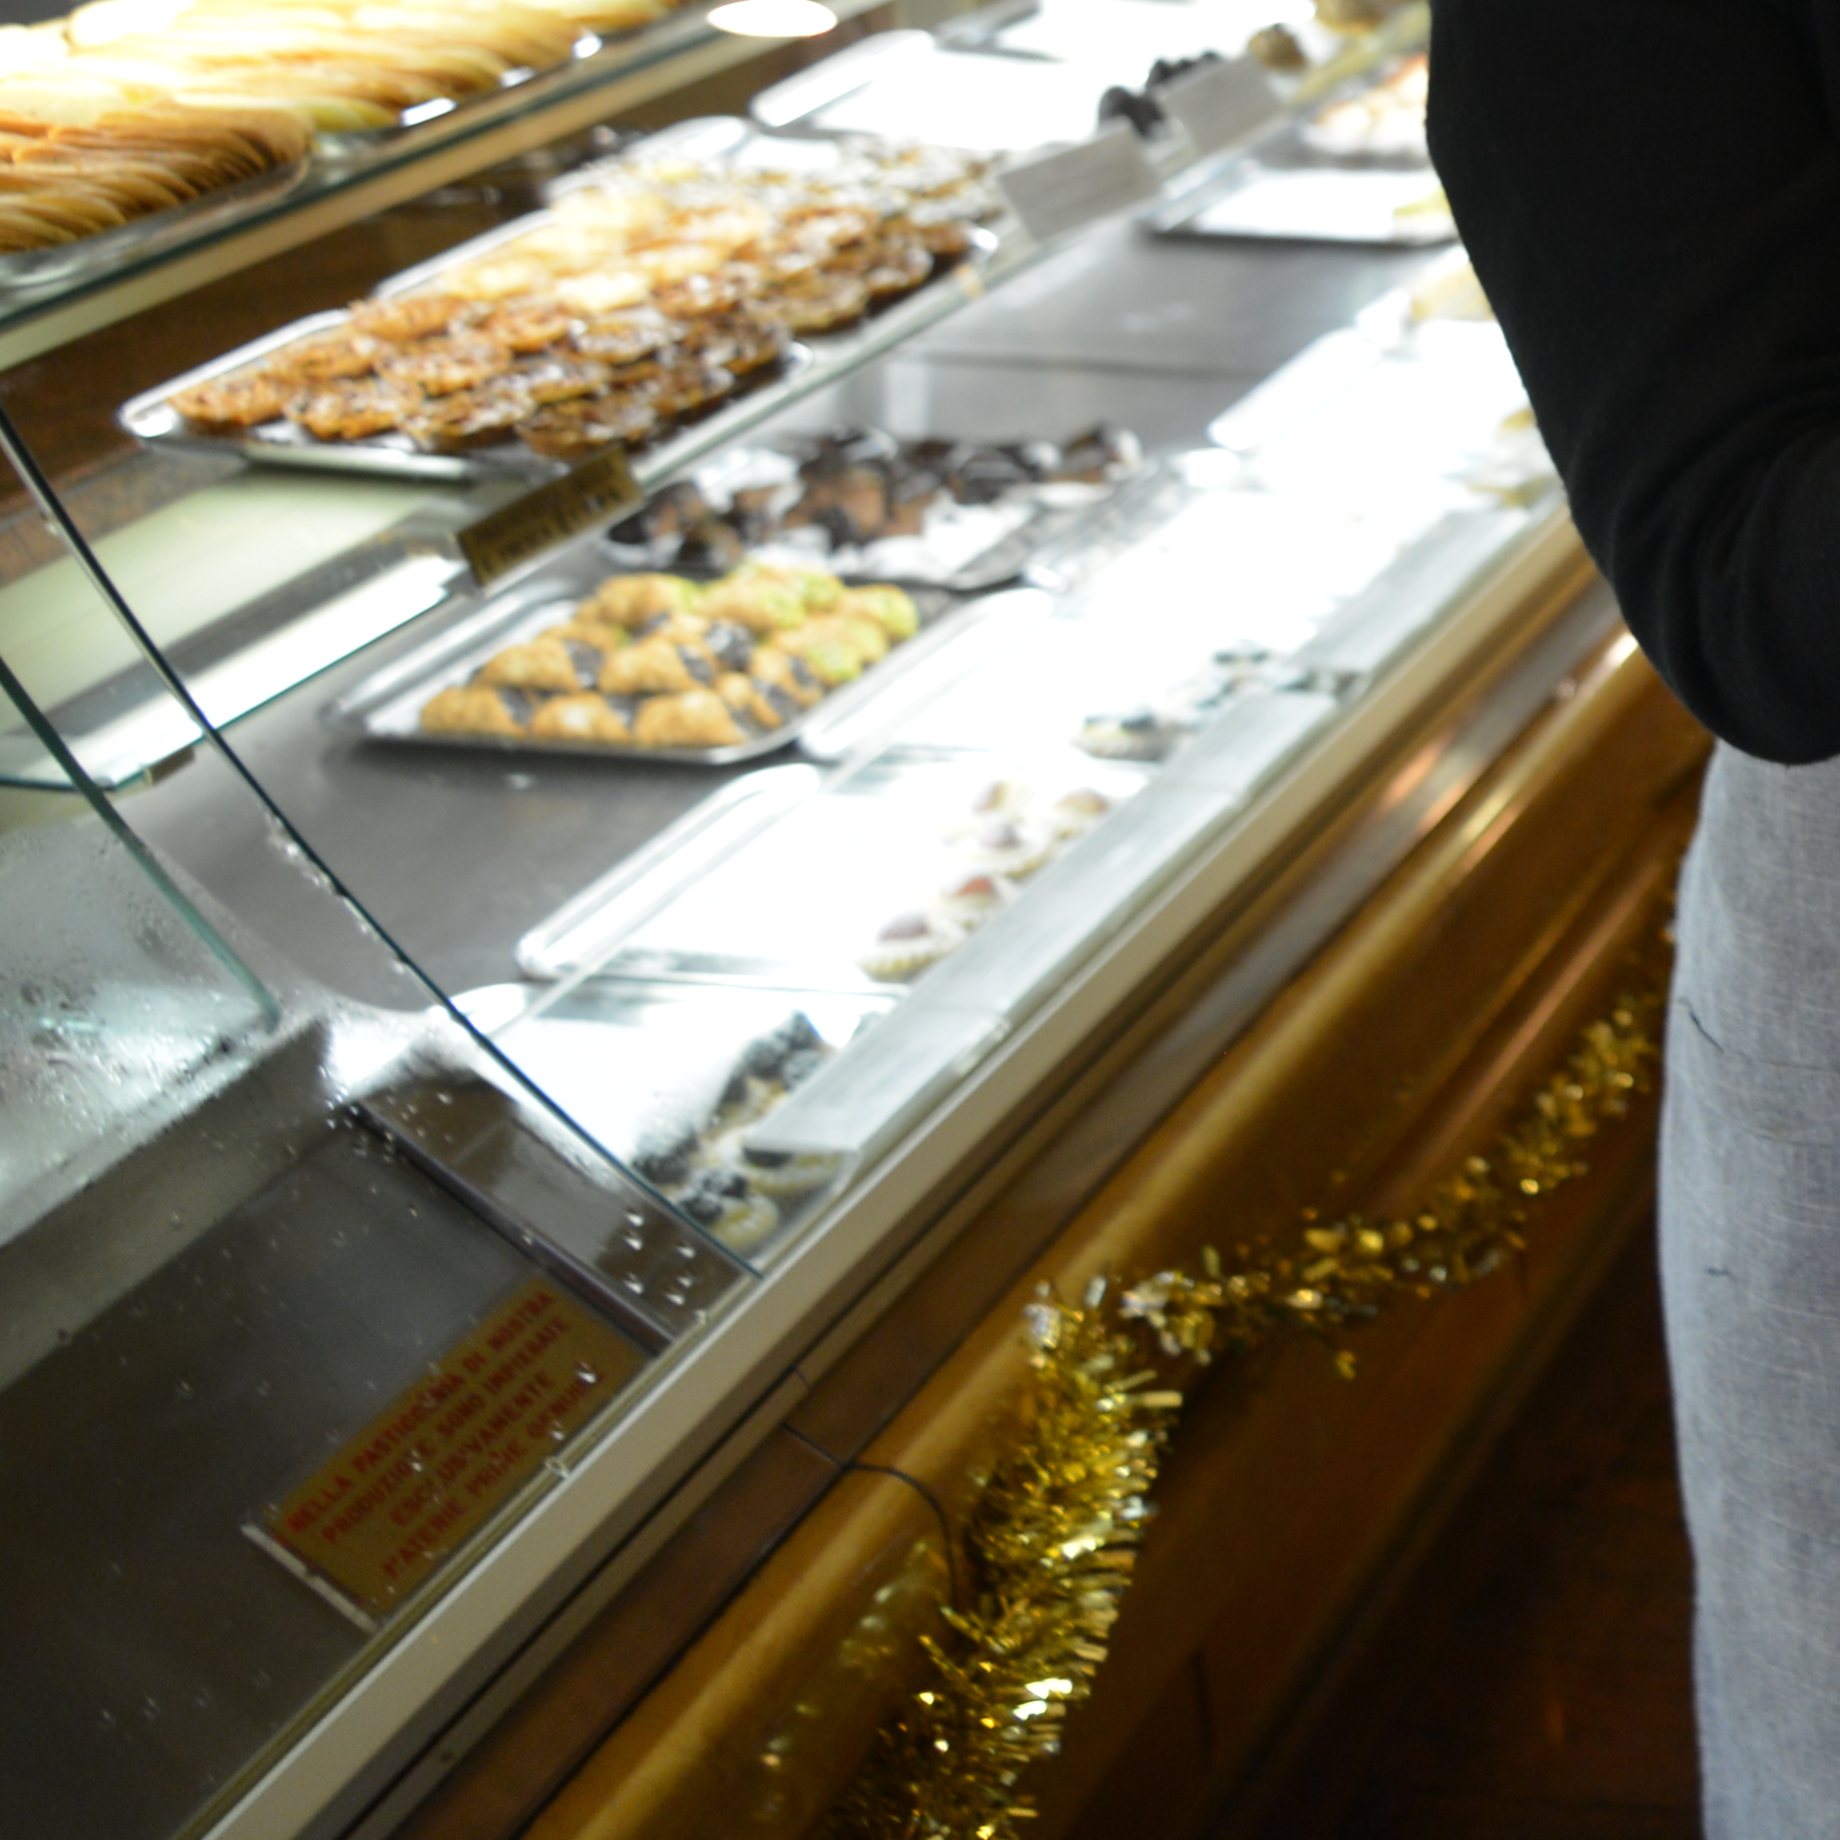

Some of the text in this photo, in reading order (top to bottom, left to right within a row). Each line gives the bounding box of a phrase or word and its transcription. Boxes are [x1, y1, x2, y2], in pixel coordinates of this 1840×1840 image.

[285, 1475, 353, 1533] NELLA
[461, 1350, 487, 1373] DI
[486, 1291, 555, 1351] NOSTRA
[436, 1393, 487, 1438] SONO
